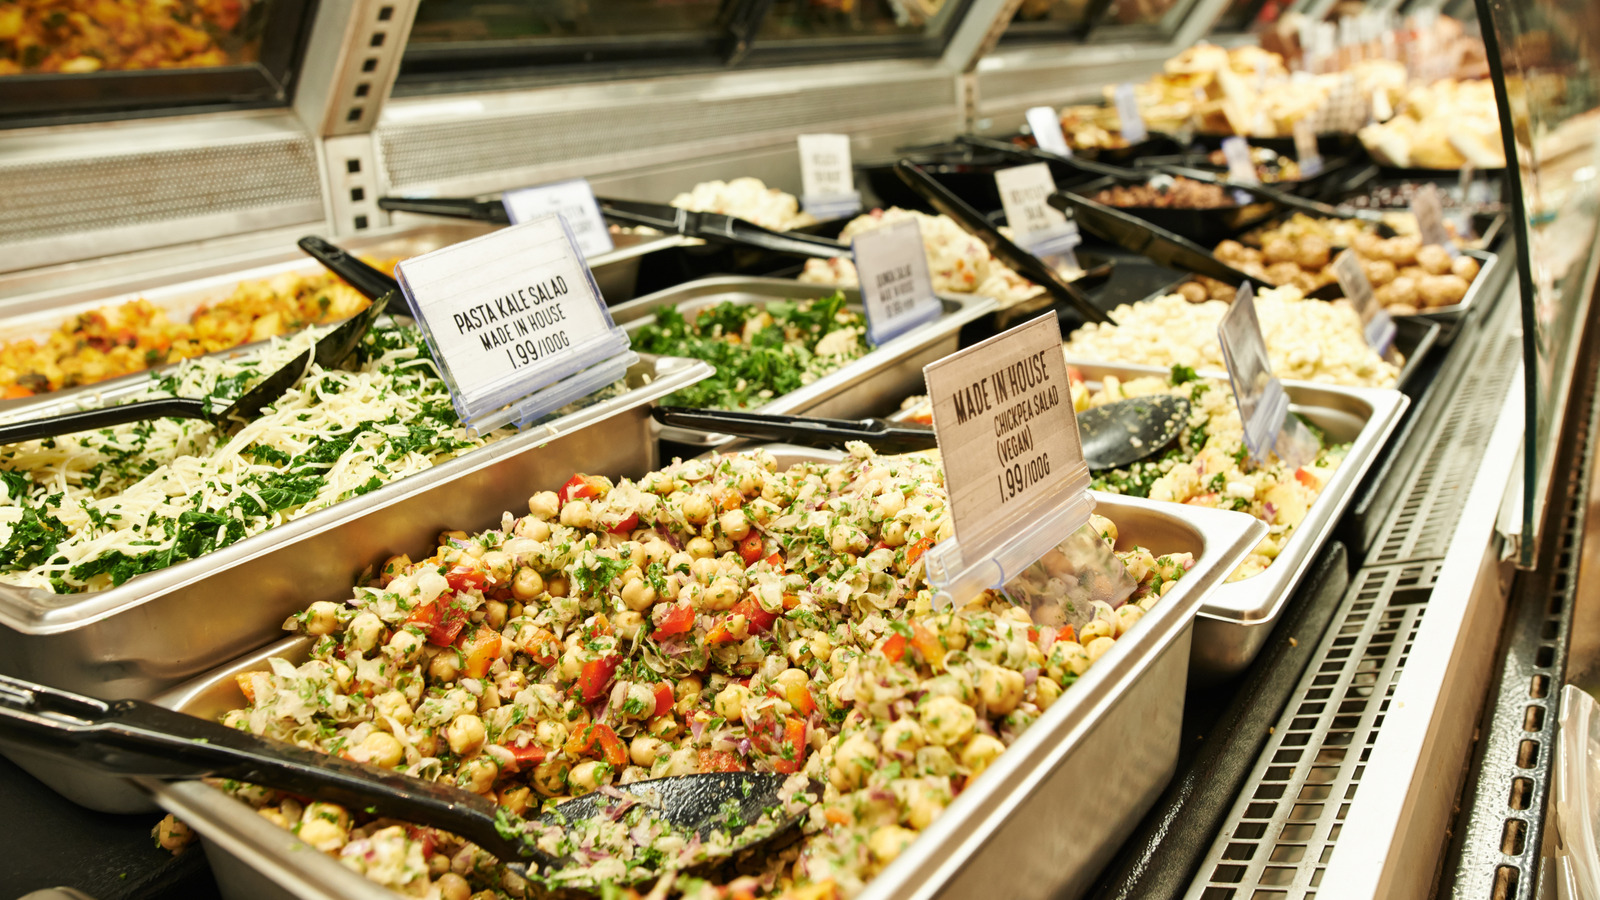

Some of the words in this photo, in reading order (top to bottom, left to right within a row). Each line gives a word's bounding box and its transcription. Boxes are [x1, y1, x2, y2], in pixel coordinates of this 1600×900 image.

[453, 303, 498, 335] PASTA
[495, 289, 531, 318] KALE
[528, 275, 569, 305] SALAD
[479, 324, 515, 352] MADE
[513, 319, 529, 341] IN
[527, 303, 566, 332] HOUSE
[505, 330, 570, 370] 1.99/100G
[953, 378, 992, 425] MADE
[992, 369, 1008, 405] IN
[1007, 350, 1049, 397] HOUSE
[993, 400, 1034, 438] CHICKPEA
[1034, 385, 1059, 416] SALAD
[996, 424, 1034, 468] (VEGAN)
[998, 452, 1050, 503] 1.99/100G
